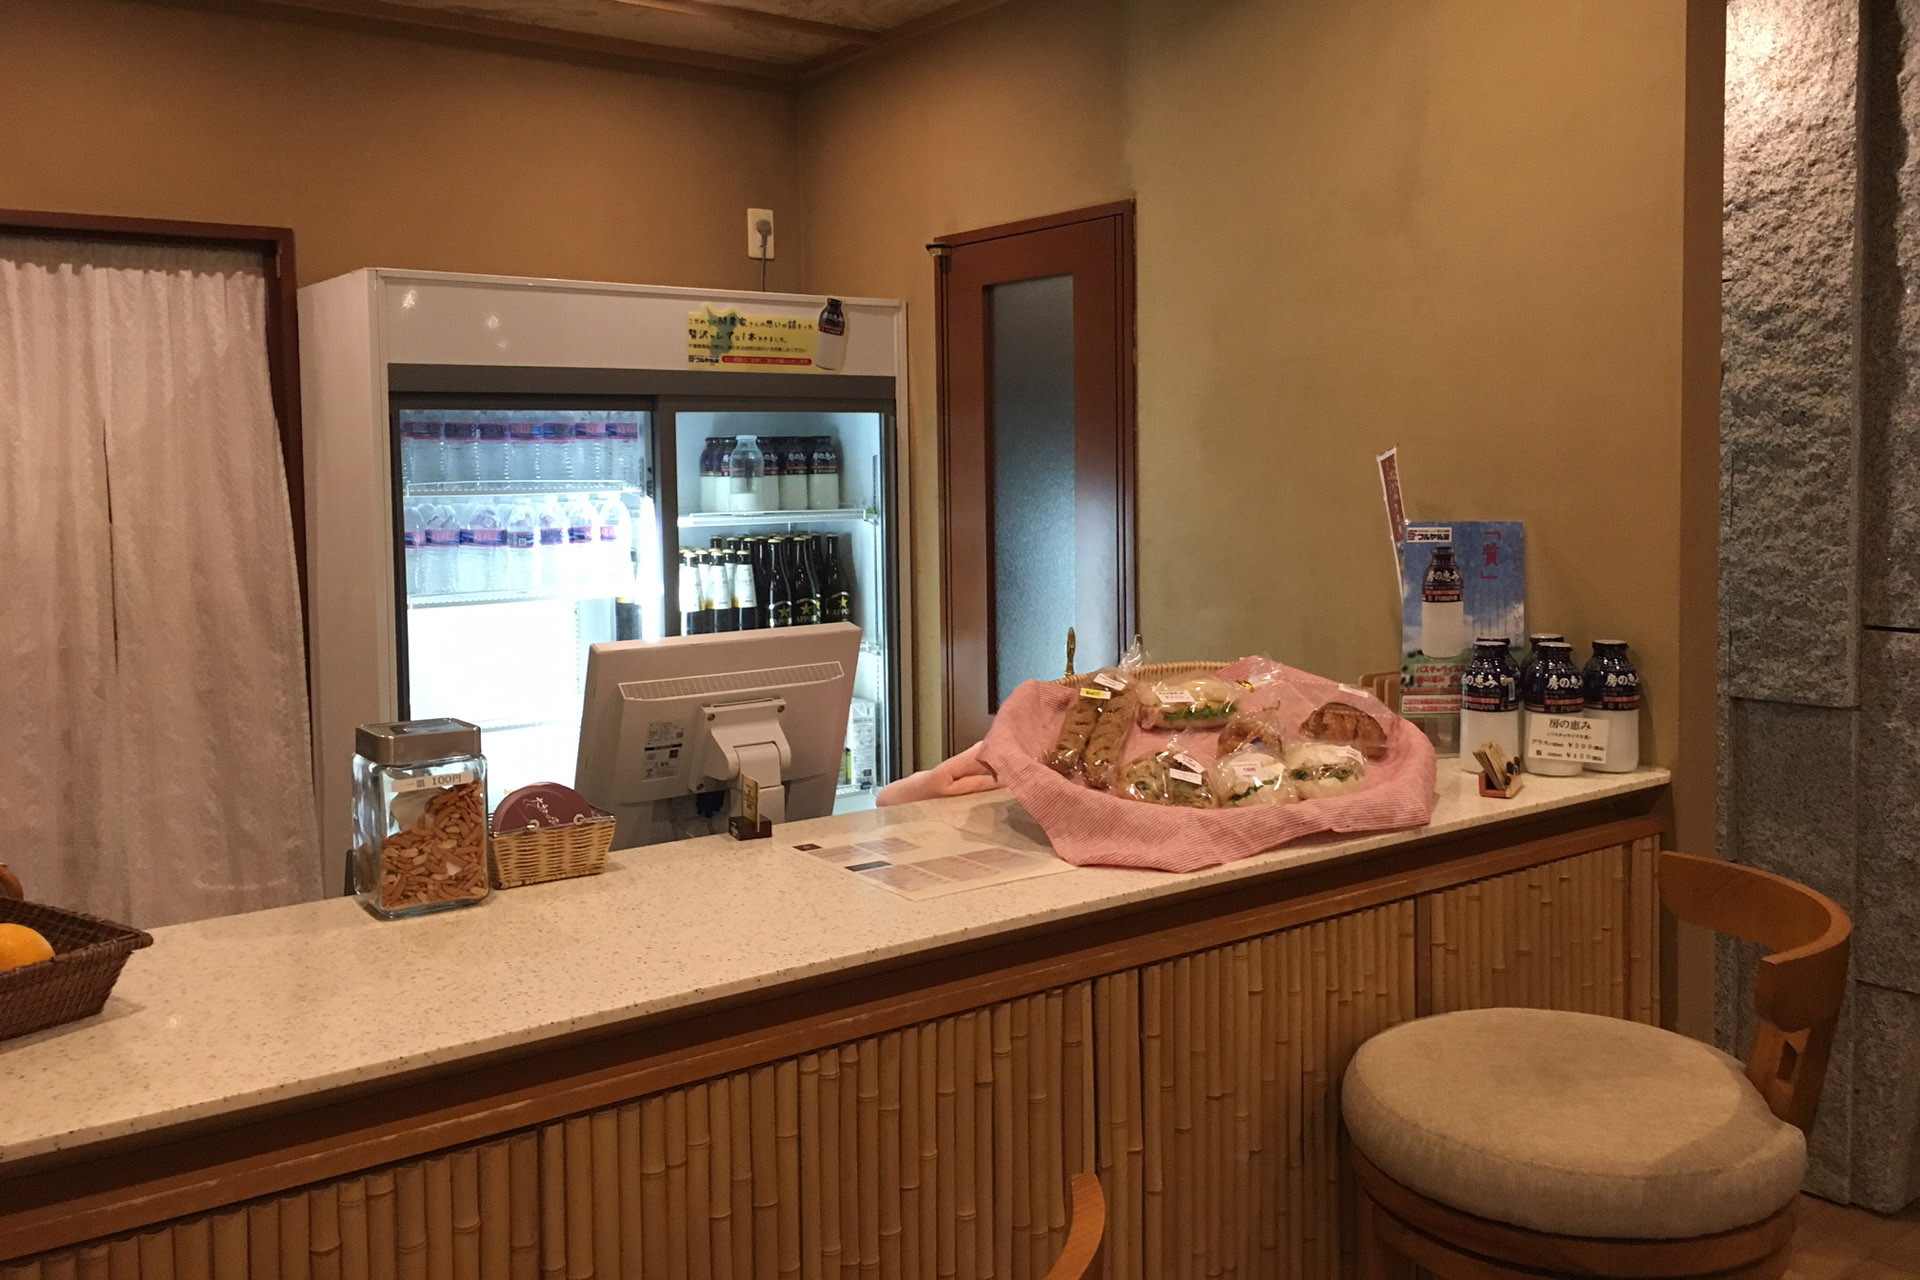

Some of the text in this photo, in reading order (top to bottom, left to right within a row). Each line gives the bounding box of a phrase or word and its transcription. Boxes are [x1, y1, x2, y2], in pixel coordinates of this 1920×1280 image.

[1548, 718, 1592, 731] 房の恵み
[432, 774, 462, 785] 100円
